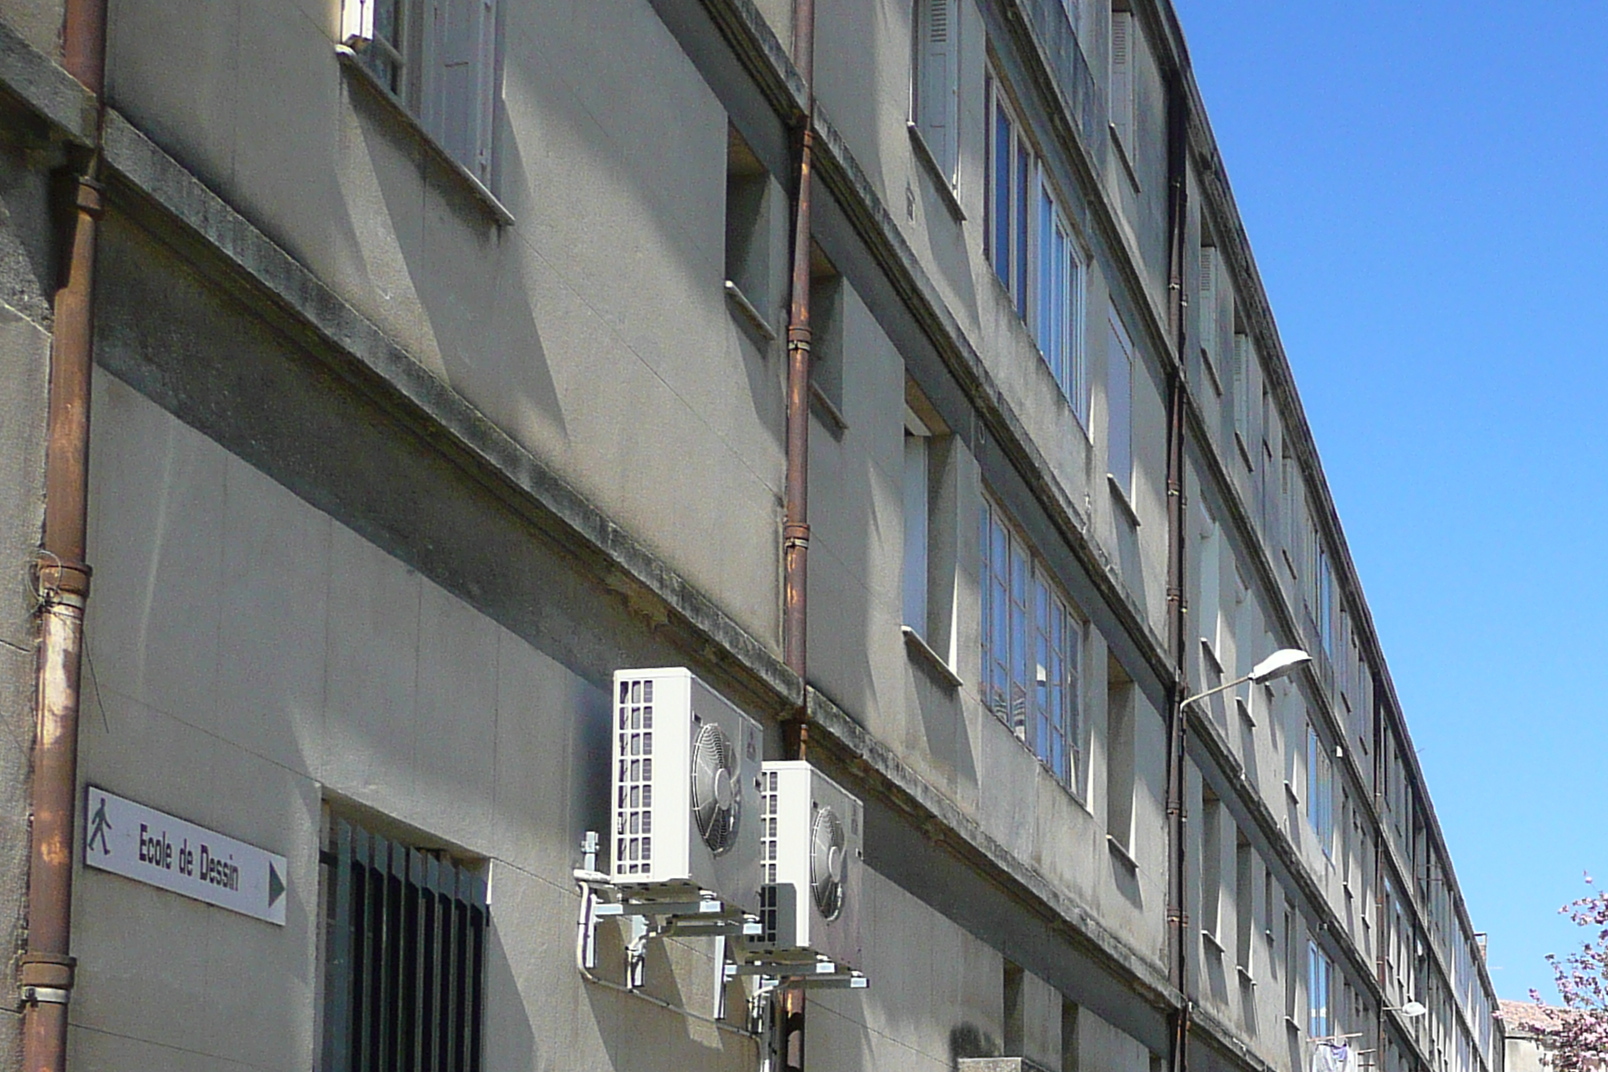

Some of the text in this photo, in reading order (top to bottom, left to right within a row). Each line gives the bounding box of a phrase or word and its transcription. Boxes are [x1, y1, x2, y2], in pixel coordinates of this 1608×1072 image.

[139, 823, 239, 891] Ecole de Dessin
